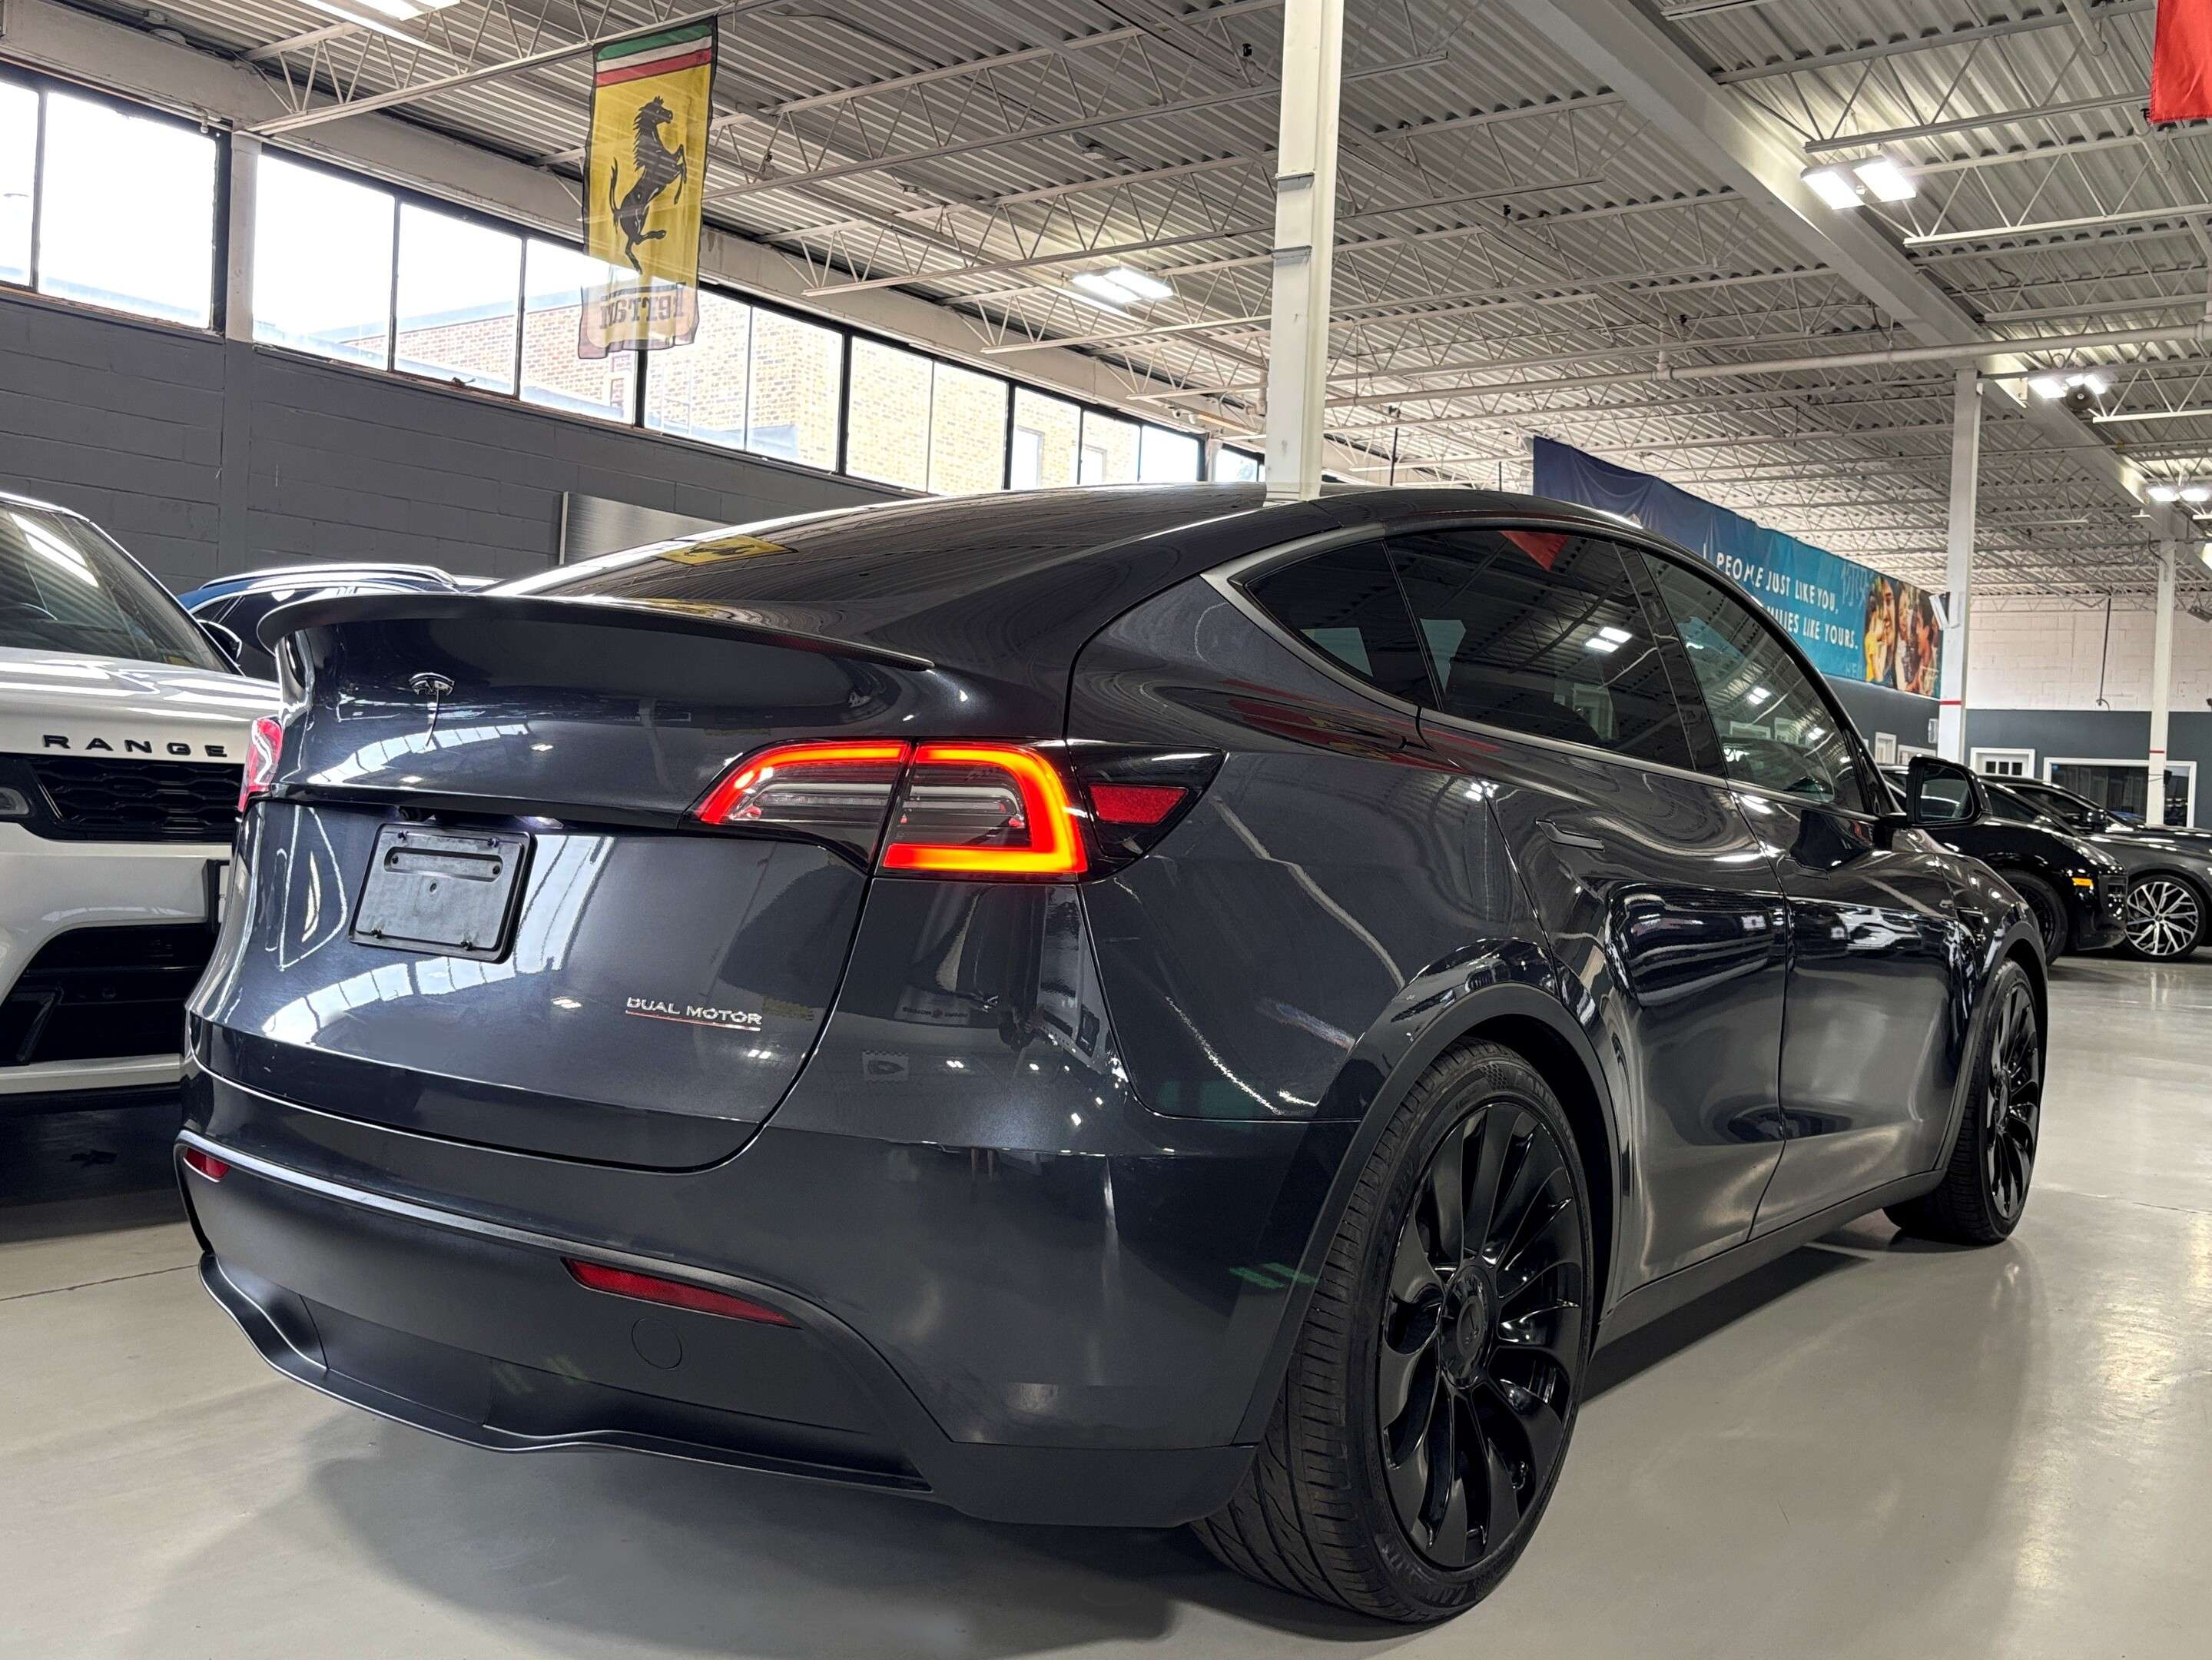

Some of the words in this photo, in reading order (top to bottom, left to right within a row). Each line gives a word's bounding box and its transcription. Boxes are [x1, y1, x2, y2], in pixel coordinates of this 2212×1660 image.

[1766, 570, 1791, 596] JUST
[1795, 579, 1815, 604] LIKE
[1817, 589, 1839, 615] YOU,
[1802, 616, 1820, 640] LIKE
[1824, 623, 1859, 650] YOURS.
[42, 734, 228, 758] RANGE
[626, 997, 681, 1015] DUAL
[686, 1005, 762, 1025] MOTOR
